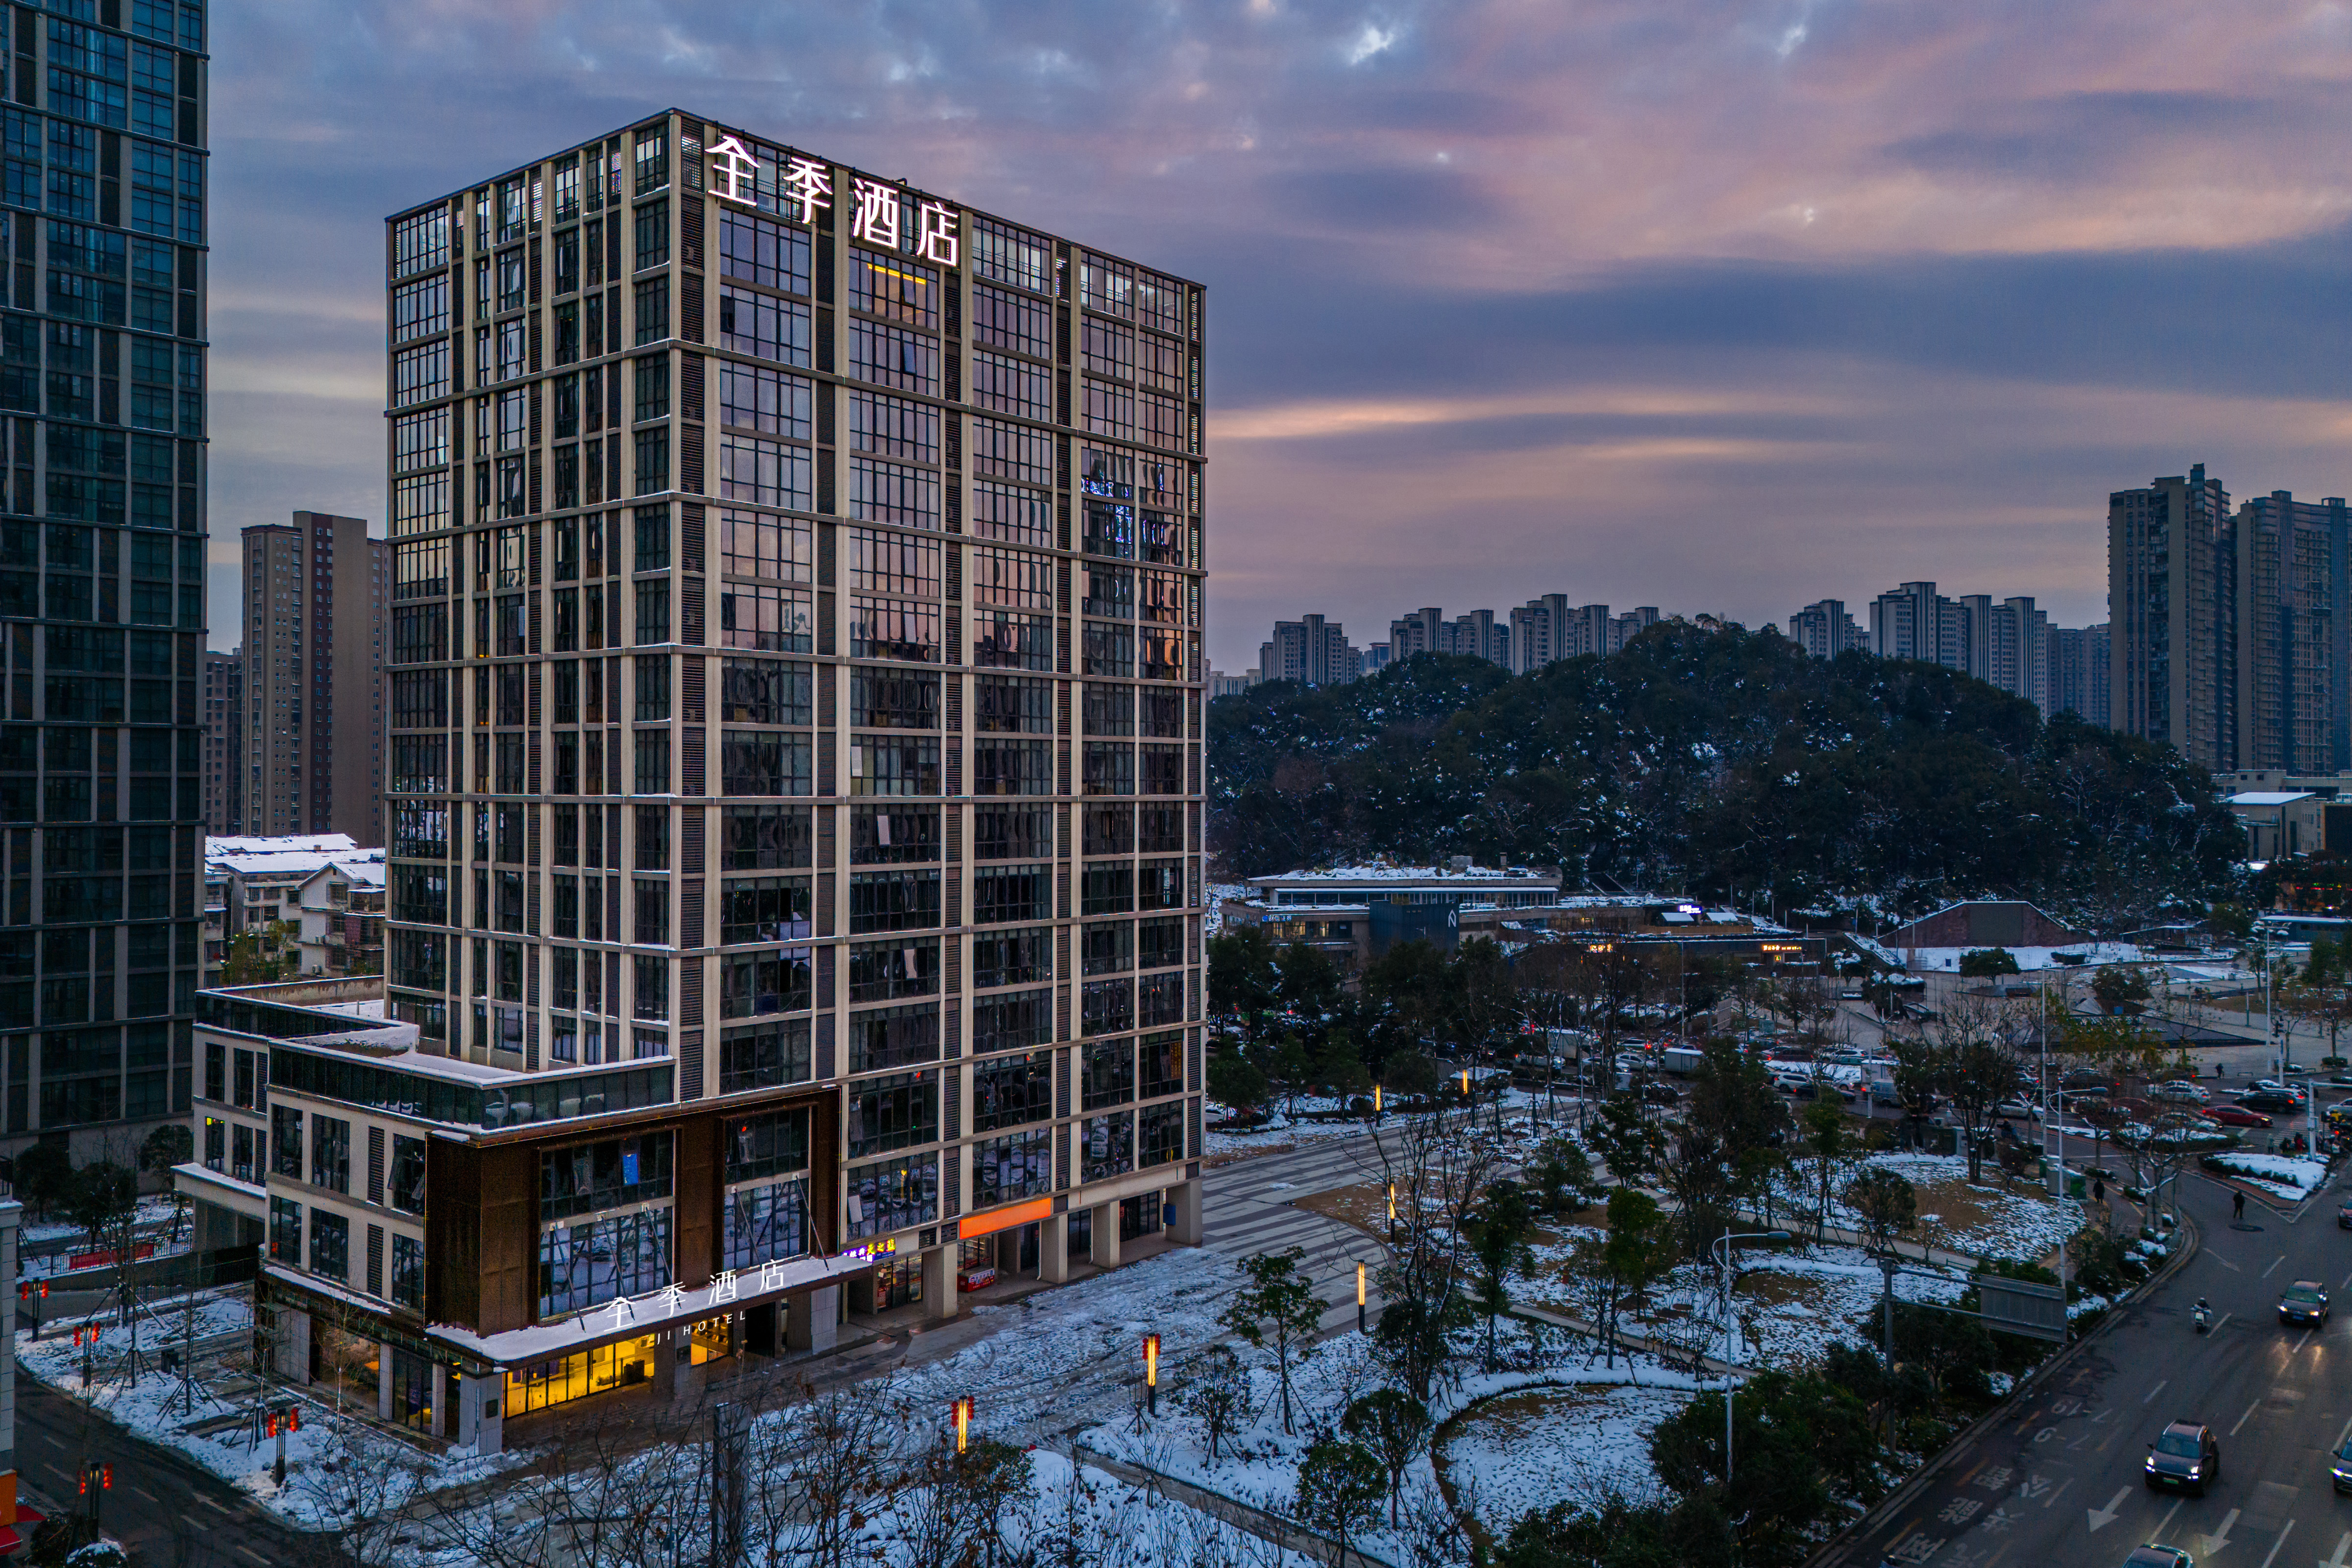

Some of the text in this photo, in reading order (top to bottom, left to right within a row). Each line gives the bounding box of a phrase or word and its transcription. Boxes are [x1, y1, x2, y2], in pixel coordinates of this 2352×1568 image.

[705, 136, 958, 266] 全季酒店
[603, 1259, 784, 1332] 全季酒店
[657, 1311, 745, 1345] JI HOTEL
